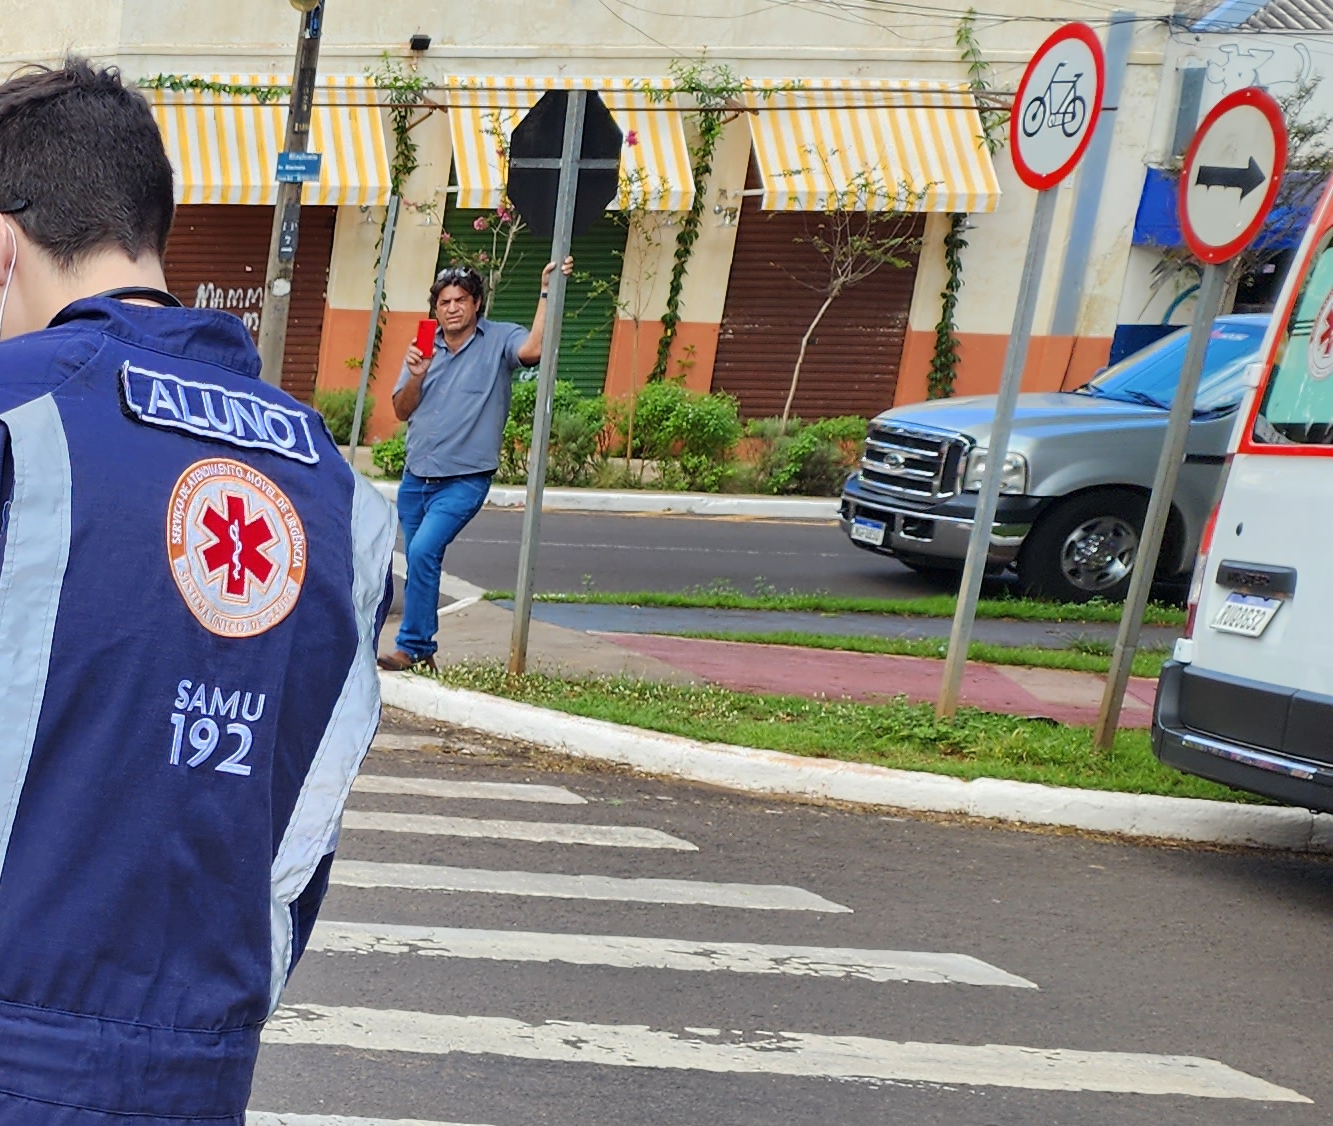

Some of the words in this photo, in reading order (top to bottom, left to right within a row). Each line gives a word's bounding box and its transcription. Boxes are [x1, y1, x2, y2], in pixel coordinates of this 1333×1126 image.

[148, 379, 296, 449] ALUNO
[277, 499, 289, 512] DE
[174, 679, 266, 722] SAMU
[169, 712, 253, 776] 192
